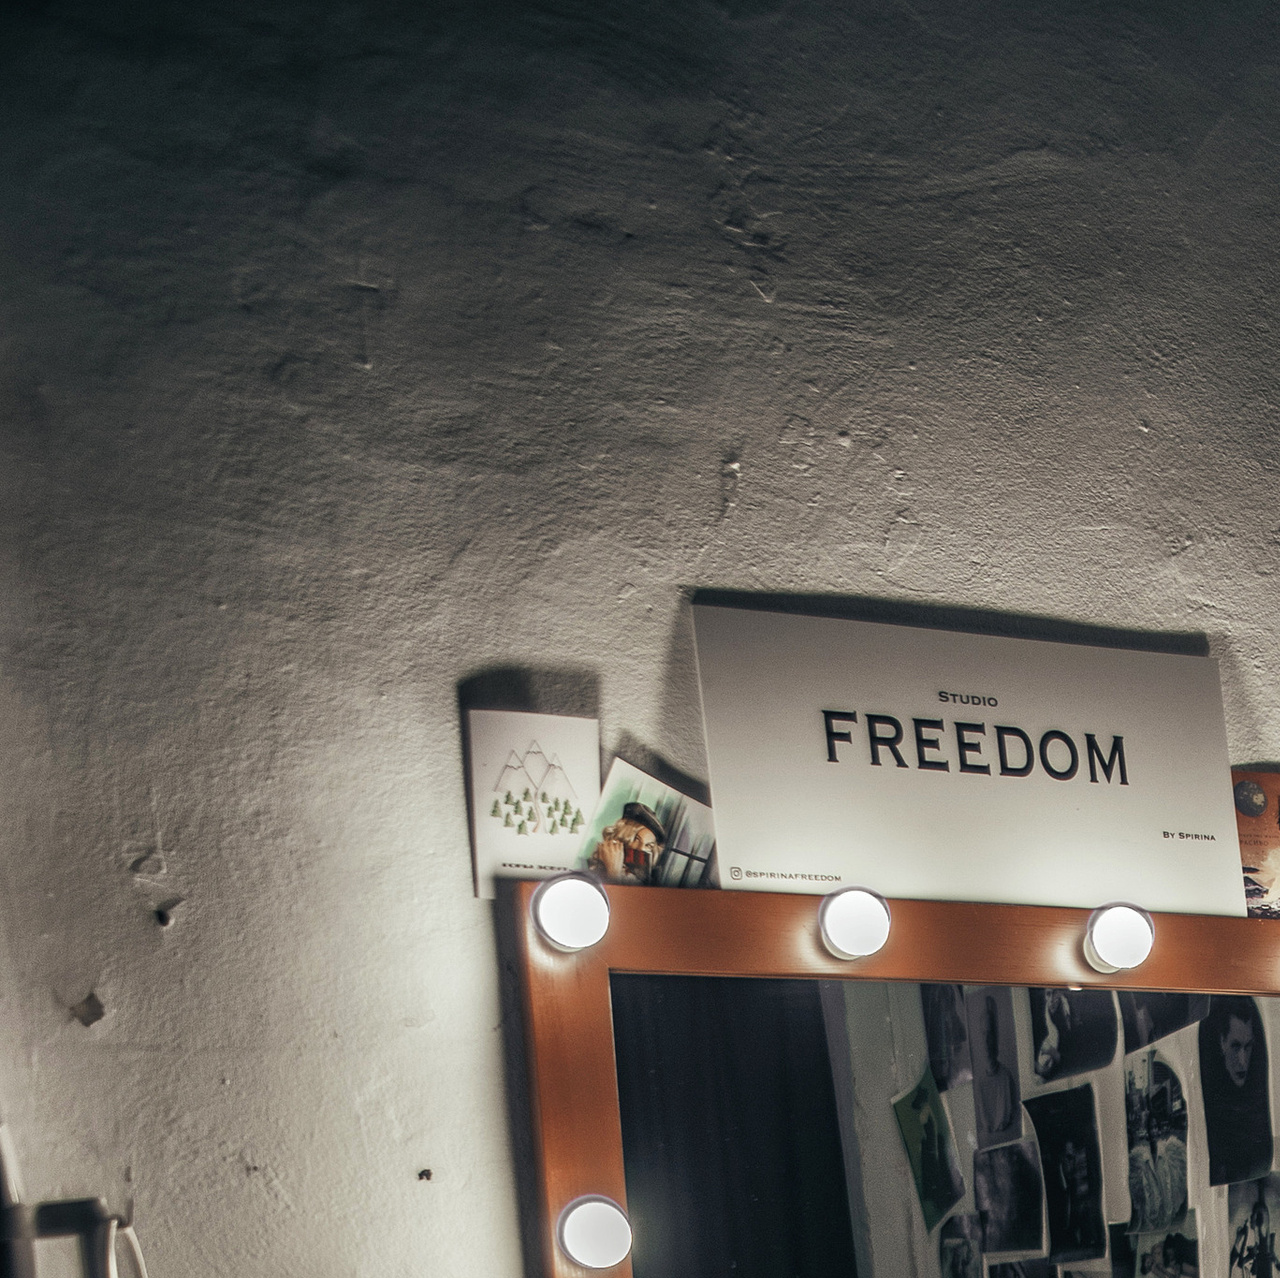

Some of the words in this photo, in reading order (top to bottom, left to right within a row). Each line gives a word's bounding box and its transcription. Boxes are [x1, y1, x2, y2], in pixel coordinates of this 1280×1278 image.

[938, 690, 998, 707] STUDIO
[821, 709, 1130, 786] FREEDOM
[1178, 831, 1217, 842] SPIRINA
[745, 869, 843, 883] @SPIRINAFREEDOM
